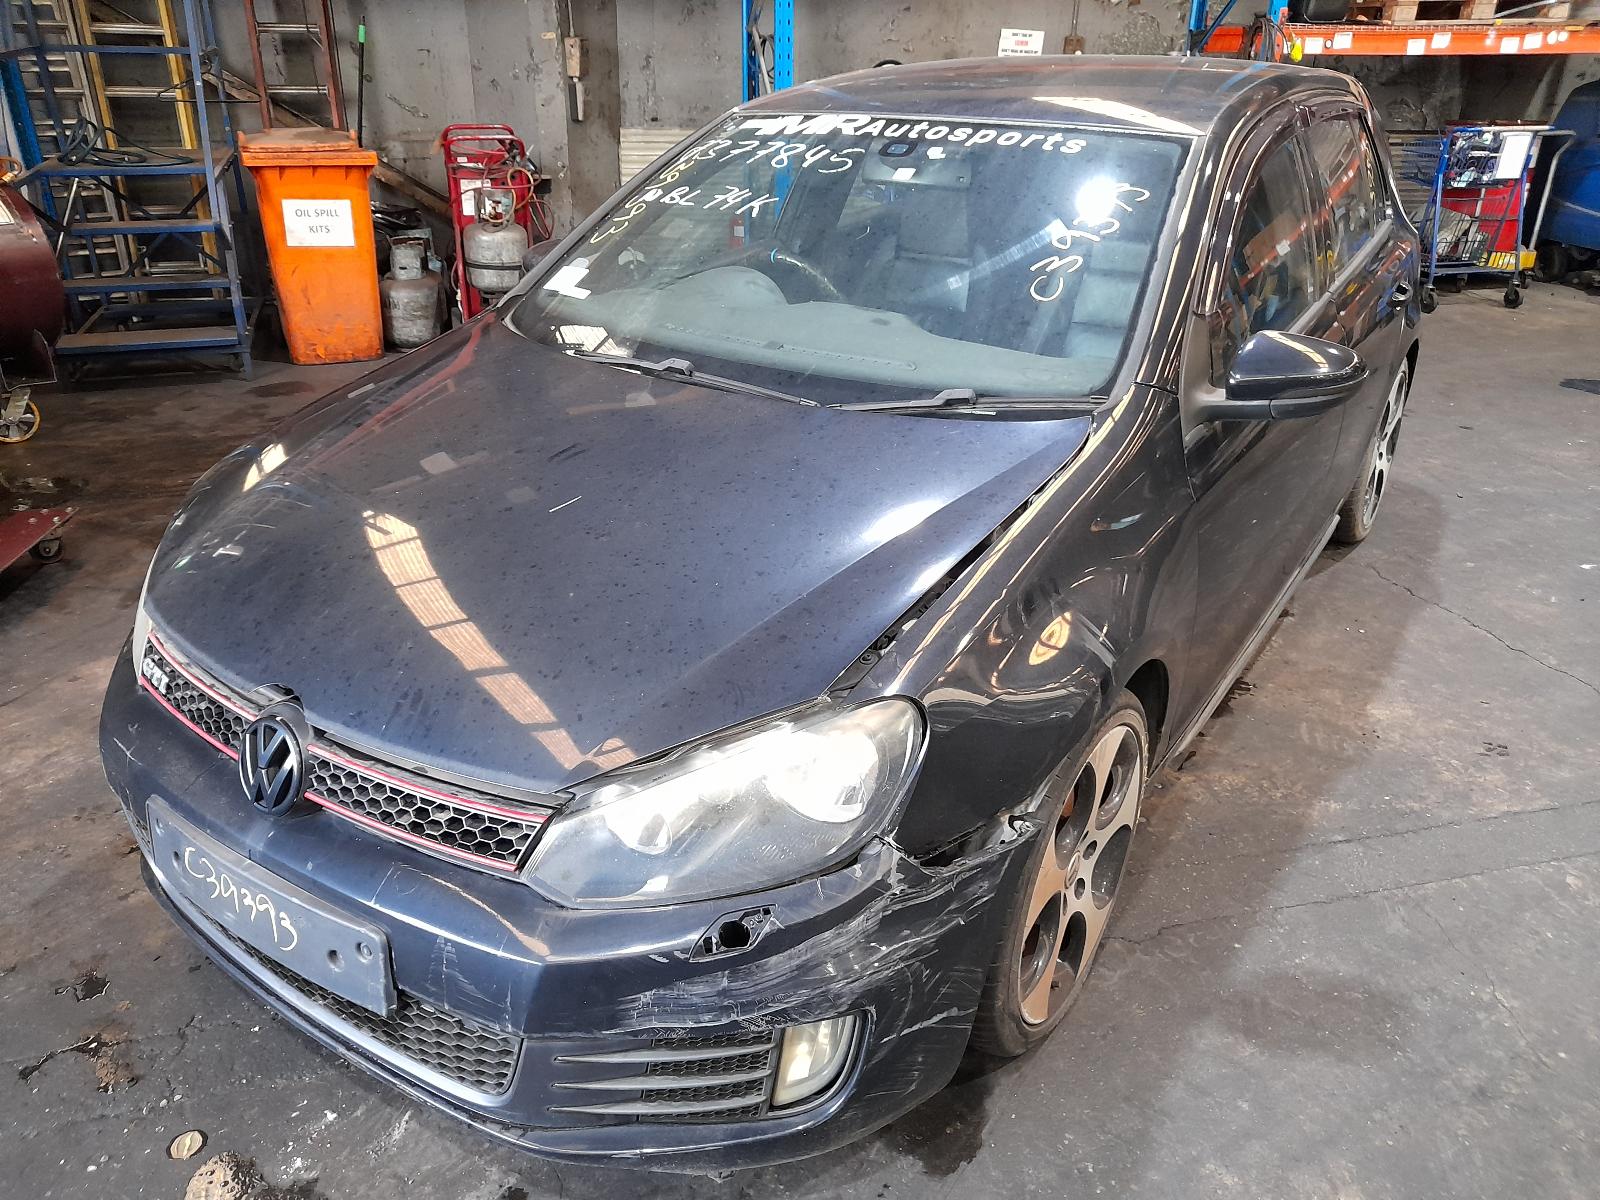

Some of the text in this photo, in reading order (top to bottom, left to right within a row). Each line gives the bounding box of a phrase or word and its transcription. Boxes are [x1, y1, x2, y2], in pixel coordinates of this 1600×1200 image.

[855, 119, 1087, 155] Autosports
[295, 208, 340, 218] OIL SPILL
[308, 225, 331, 234] KITS
[143, 657, 170, 695] GTI
[184, 847, 298, 951] C39393
